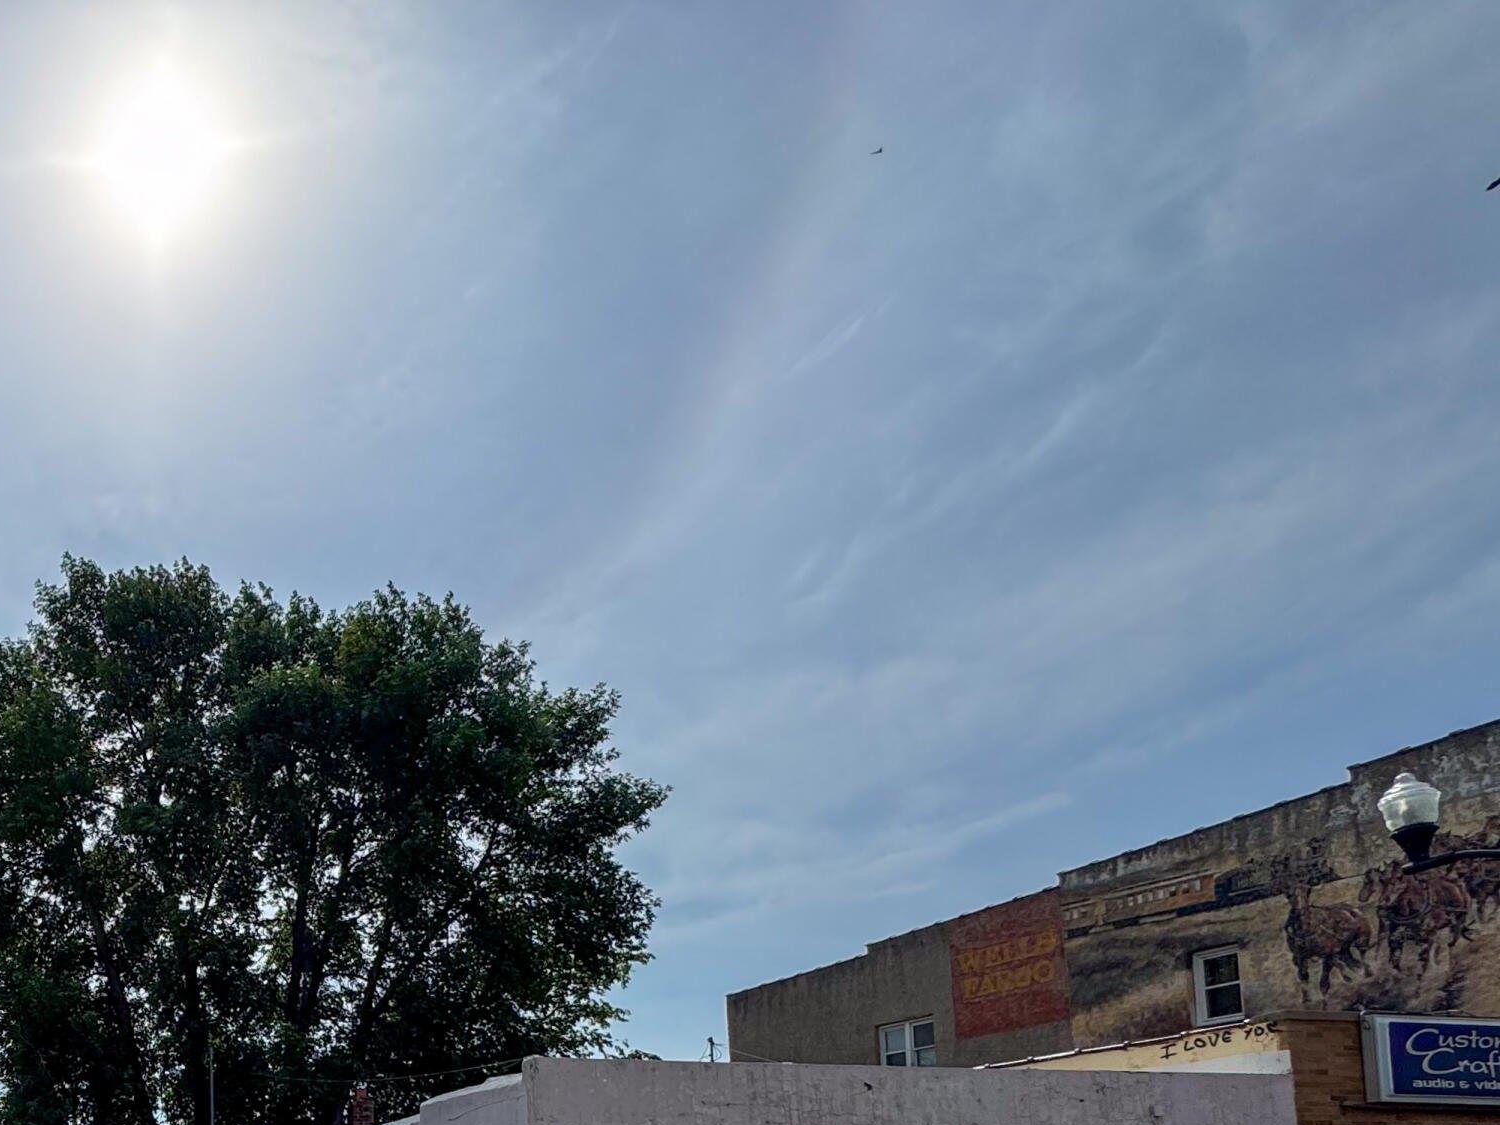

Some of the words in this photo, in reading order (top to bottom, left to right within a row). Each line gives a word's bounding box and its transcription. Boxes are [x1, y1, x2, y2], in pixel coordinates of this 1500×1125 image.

[1160, 1043, 1177, 1059] I
[1184, 1031, 1232, 1052] LOVE
[1413, 1078, 1455, 1089] audio
